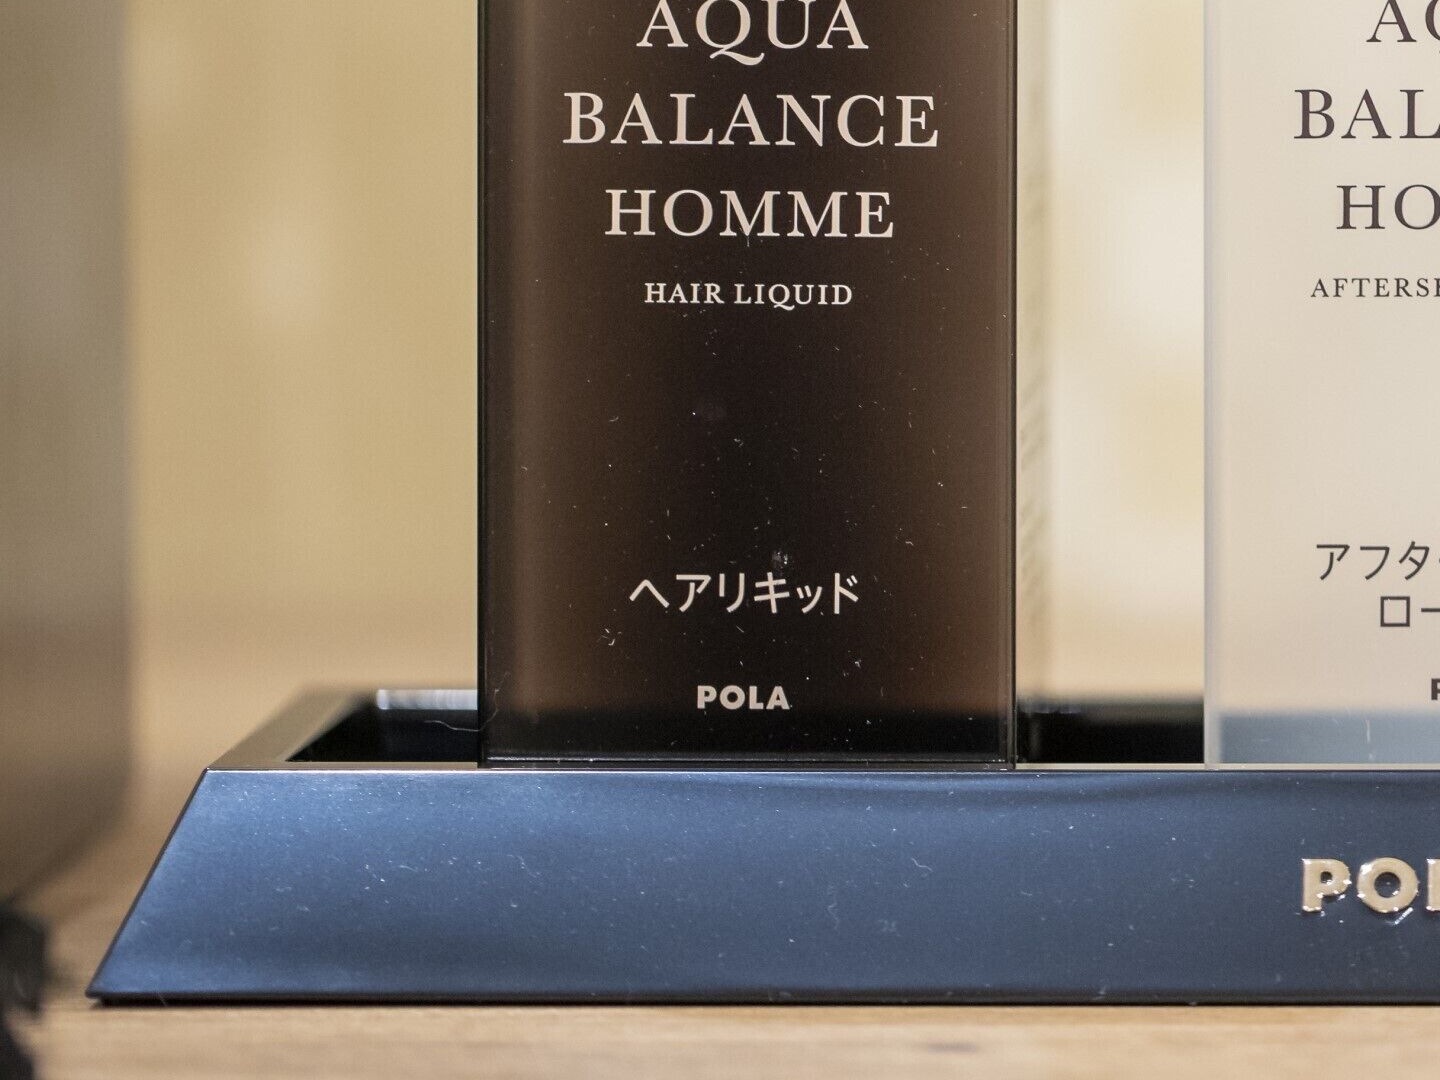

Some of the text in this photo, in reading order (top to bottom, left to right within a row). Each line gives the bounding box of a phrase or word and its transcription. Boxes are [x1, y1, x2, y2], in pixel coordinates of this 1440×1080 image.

[563, 92, 938, 147] BALANCE
[605, 190, 893, 237] HOMME
[645, 283, 852, 310] HAIR LIQUID
[630, 572, 858, 614] ヘアリキッド
[697, 685, 789, 709] POLA
